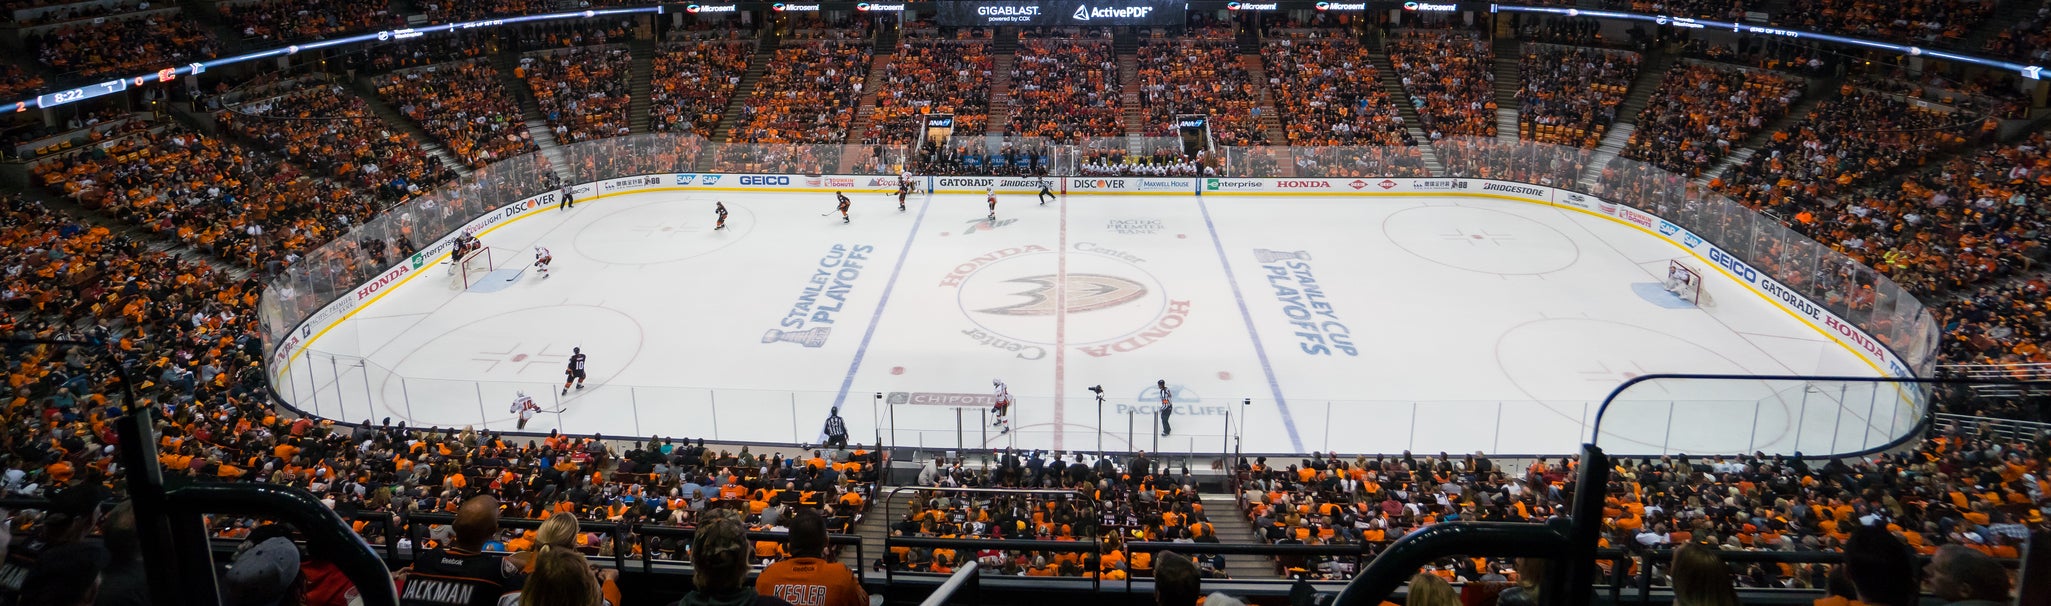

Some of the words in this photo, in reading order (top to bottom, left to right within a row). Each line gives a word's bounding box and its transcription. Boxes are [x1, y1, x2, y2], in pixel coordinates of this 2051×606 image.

[700, 4, 736, 12] Microsemi
[870, 3, 905, 11] Microsemi
[1241, 2, 1277, 10] Microsemi
[1329, 2, 1366, 10] Microsemi
[1418, 3, 1456, 11] Microsemi
[54, 89, 84, 103] 8:22
[16, 101, 27, 112] 2
[740, 176, 790, 185] GEICO
[939, 178, 994, 187] GATORADE
[1074, 179, 1125, 189] DISCOVER
[1209, 180, 1262, 189] enterprise
[1277, 180, 1331, 188] HONDA
[1483, 182, 1545, 197] BRIDGESTONE
[505, 193, 555, 217] DISCOVER
[484, 213, 503, 226] LIGHT
[1628, 216, 1651, 228] DONUTS
[413, 236, 457, 266] enterprise
[1074, 241, 1146, 263] Center
[939, 244, 1051, 287] HONDA
[1709, 247, 1757, 284] GEICO
[357, 265, 410, 300] HONDA
[780, 268, 831, 329] STANLEY
[820, 243, 847, 268] CUP
[810, 244, 874, 324] PLAYOFFS
[1761, 279, 1821, 321] GATORADE
[1262, 265, 1332, 356] PLAYOFFS
[1285, 261, 1339, 320] STANLEY
[1321, 320, 1359, 357] CUP
[1076, 299, 1190, 358] HONDA
[961, 328, 1047, 361] Center
[1824, 314, 1886, 363] HONDA
[575, 360, 584, 371] 10
[914, 394, 993, 404] CHIPOTL
[1116, 403, 1186, 415] PACIC
[1188, 404, 1226, 416] LIFE
[441, 557, 464, 566] Reebok
[402, 579, 474, 605] JACKMAN
[773, 584, 827, 606] KESLER
